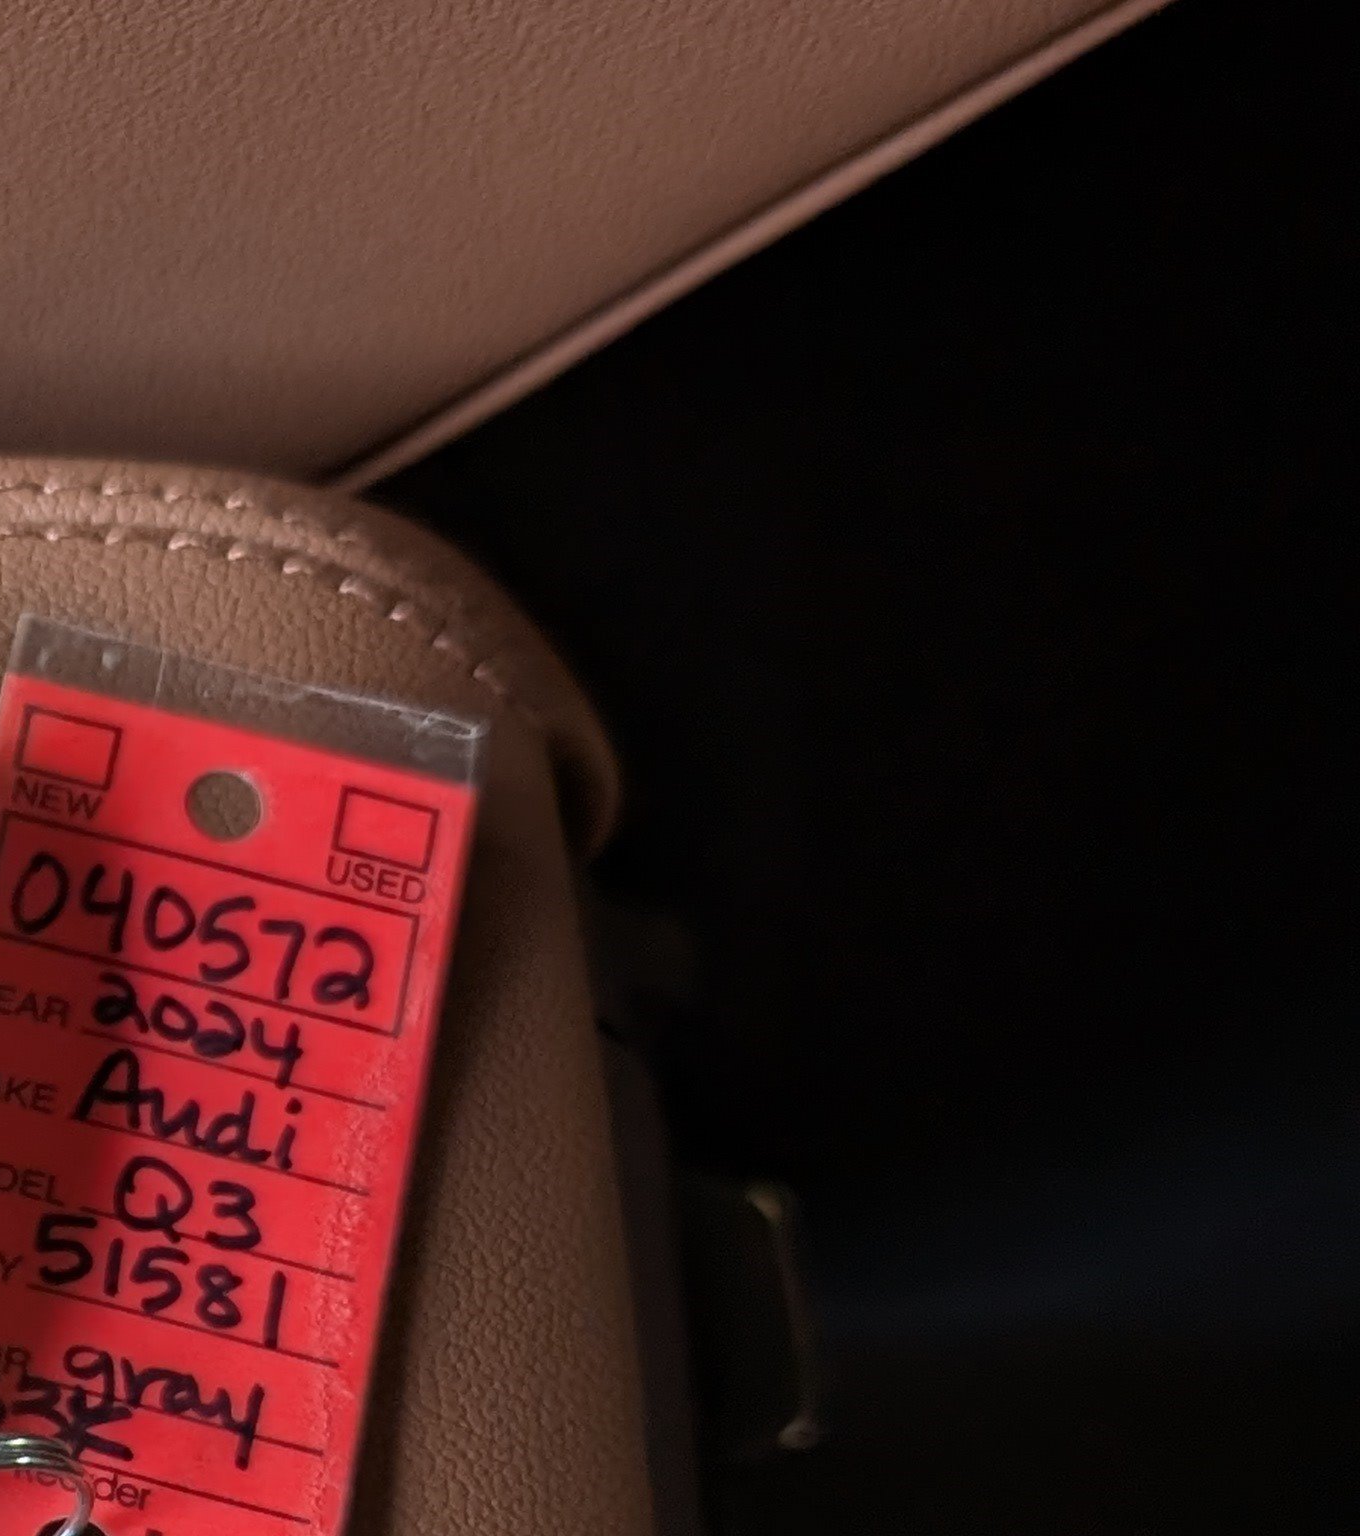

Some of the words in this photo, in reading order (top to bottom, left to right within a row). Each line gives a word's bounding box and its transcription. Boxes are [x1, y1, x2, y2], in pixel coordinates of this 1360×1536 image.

[12, 777, 103, 820] NEW
[11, 851, 376, 1009] 040572
[325, 856, 426, 904] USED
[92, 971, 304, 1088] 2024
[73, 1048, 304, 1170] Audi
[33, 1213, 286, 1350] 51581
[64, 1345, 265, 1472] gray
